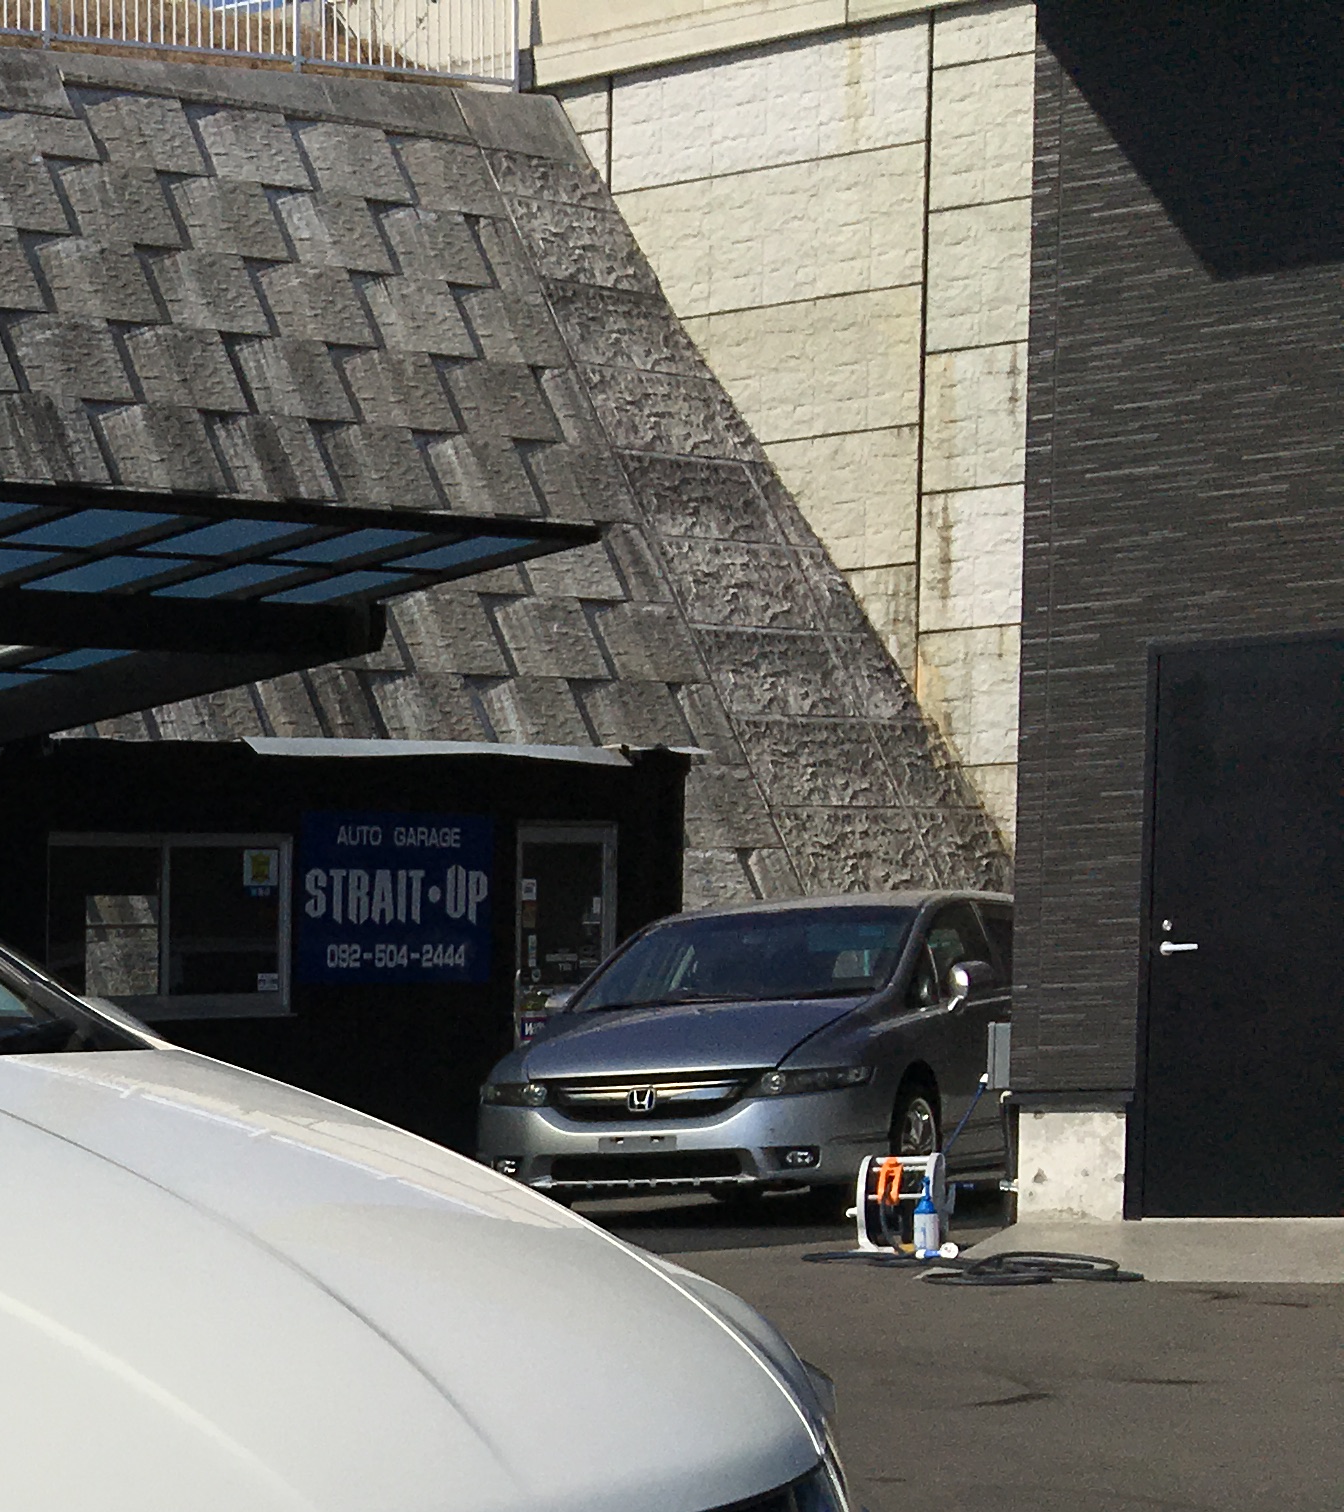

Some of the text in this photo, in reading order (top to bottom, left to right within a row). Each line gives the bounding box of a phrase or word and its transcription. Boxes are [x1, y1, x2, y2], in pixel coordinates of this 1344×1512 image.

[337, 825, 461, 847] AUTO GARAGE
[326, 944, 465, 969] 092-504-2444
